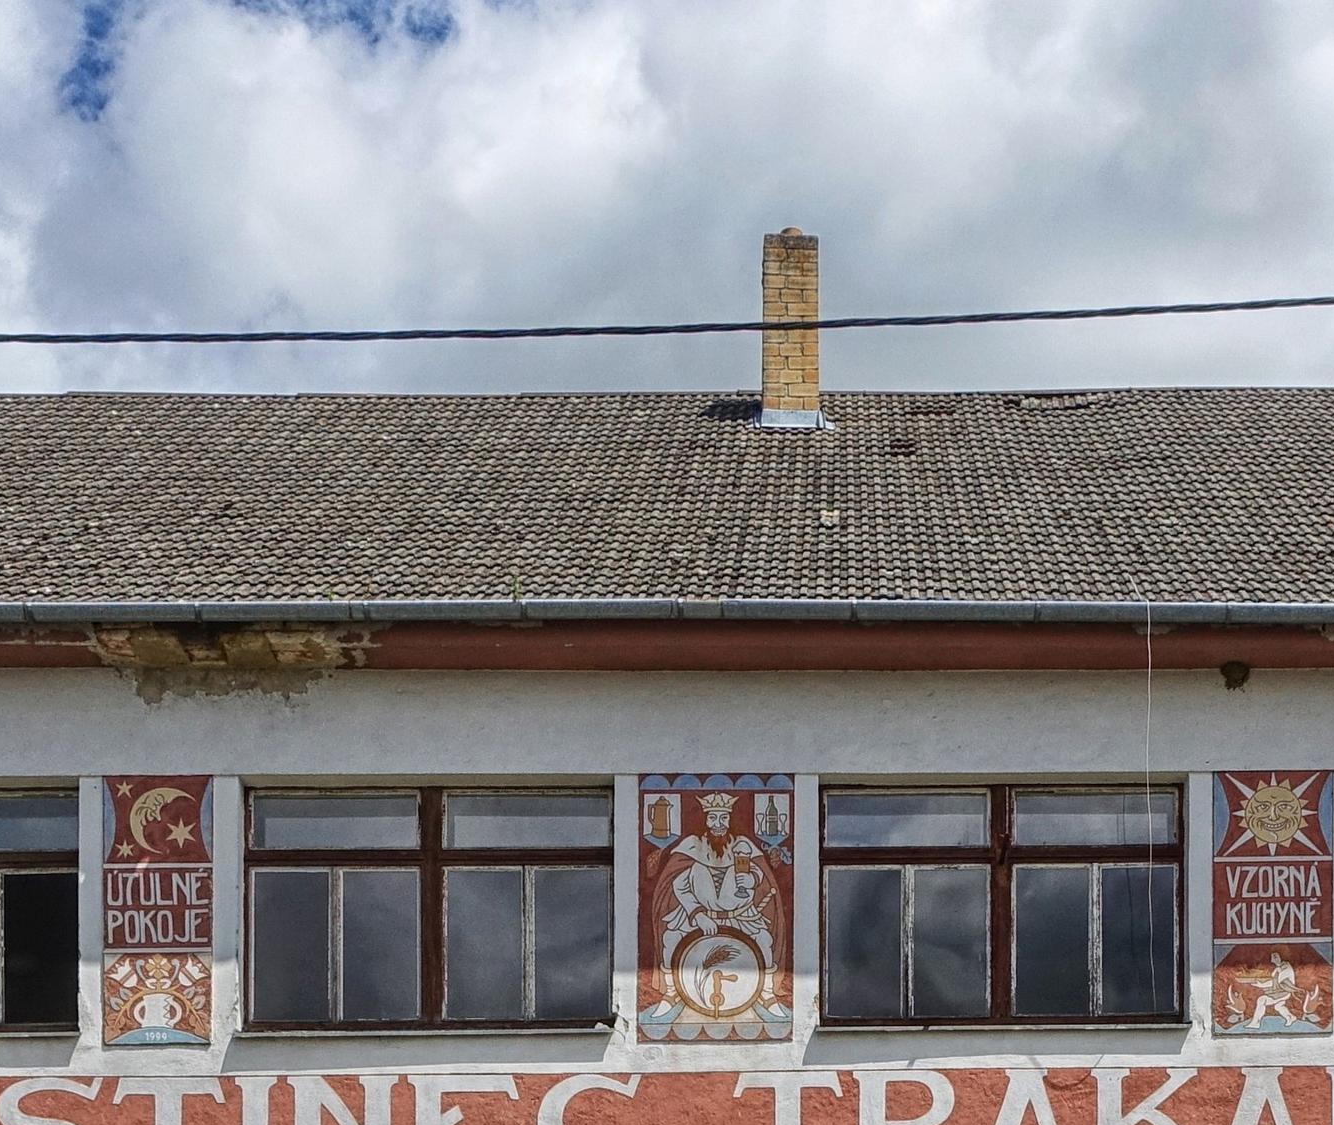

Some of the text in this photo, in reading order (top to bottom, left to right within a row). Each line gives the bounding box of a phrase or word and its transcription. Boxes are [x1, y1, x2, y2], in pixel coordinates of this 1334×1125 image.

[106, 868, 209, 906] ÚTULNÉ
[1226, 861, 1321, 898] VZORNÁ
[107, 908, 209, 944] POKOJE
[1226, 898, 1321, 934] KUCHYNĚ
[145, 1031, 167, 1041] 1999
